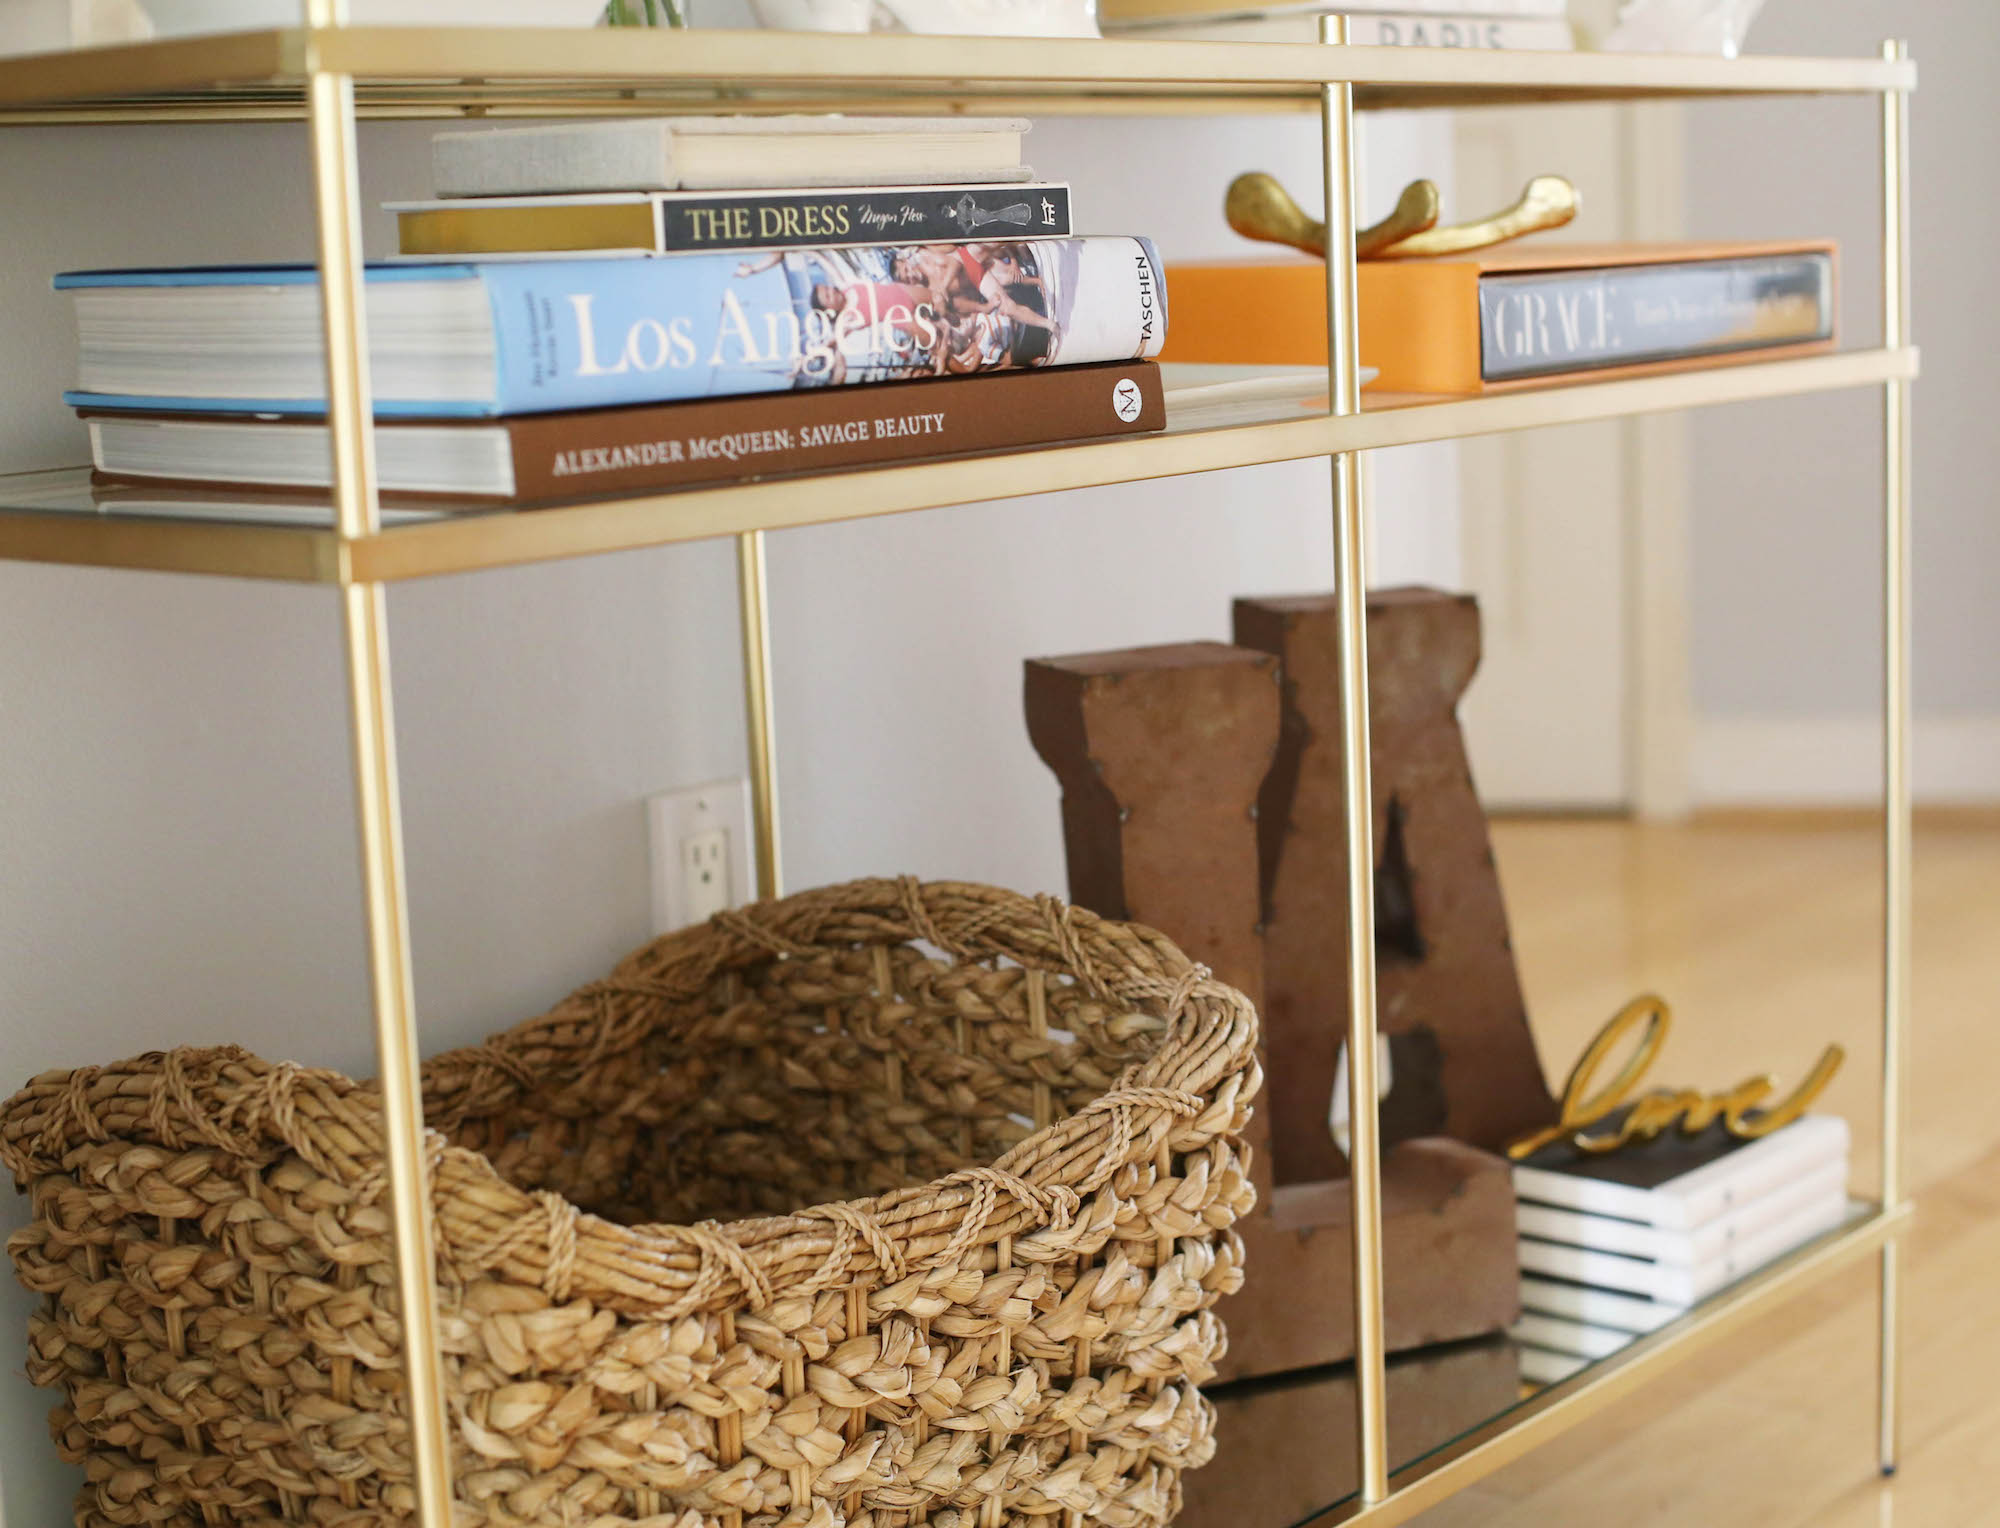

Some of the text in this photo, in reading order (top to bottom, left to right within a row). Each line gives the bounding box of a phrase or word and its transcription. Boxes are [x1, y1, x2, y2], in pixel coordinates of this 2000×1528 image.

[684, 204, 850, 241] THE DRESS
[568, 292, 697, 376] Los
[707, 281, 938, 377] Angeles
[1135, 256, 1153, 343] TASCHEN
[1494, 284, 1622, 357] GRACE
[552, 440, 685, 476] ALEXANDER
[800, 420, 870, 447] SAVAGE
[874, 413, 945, 438] BEAUTY
